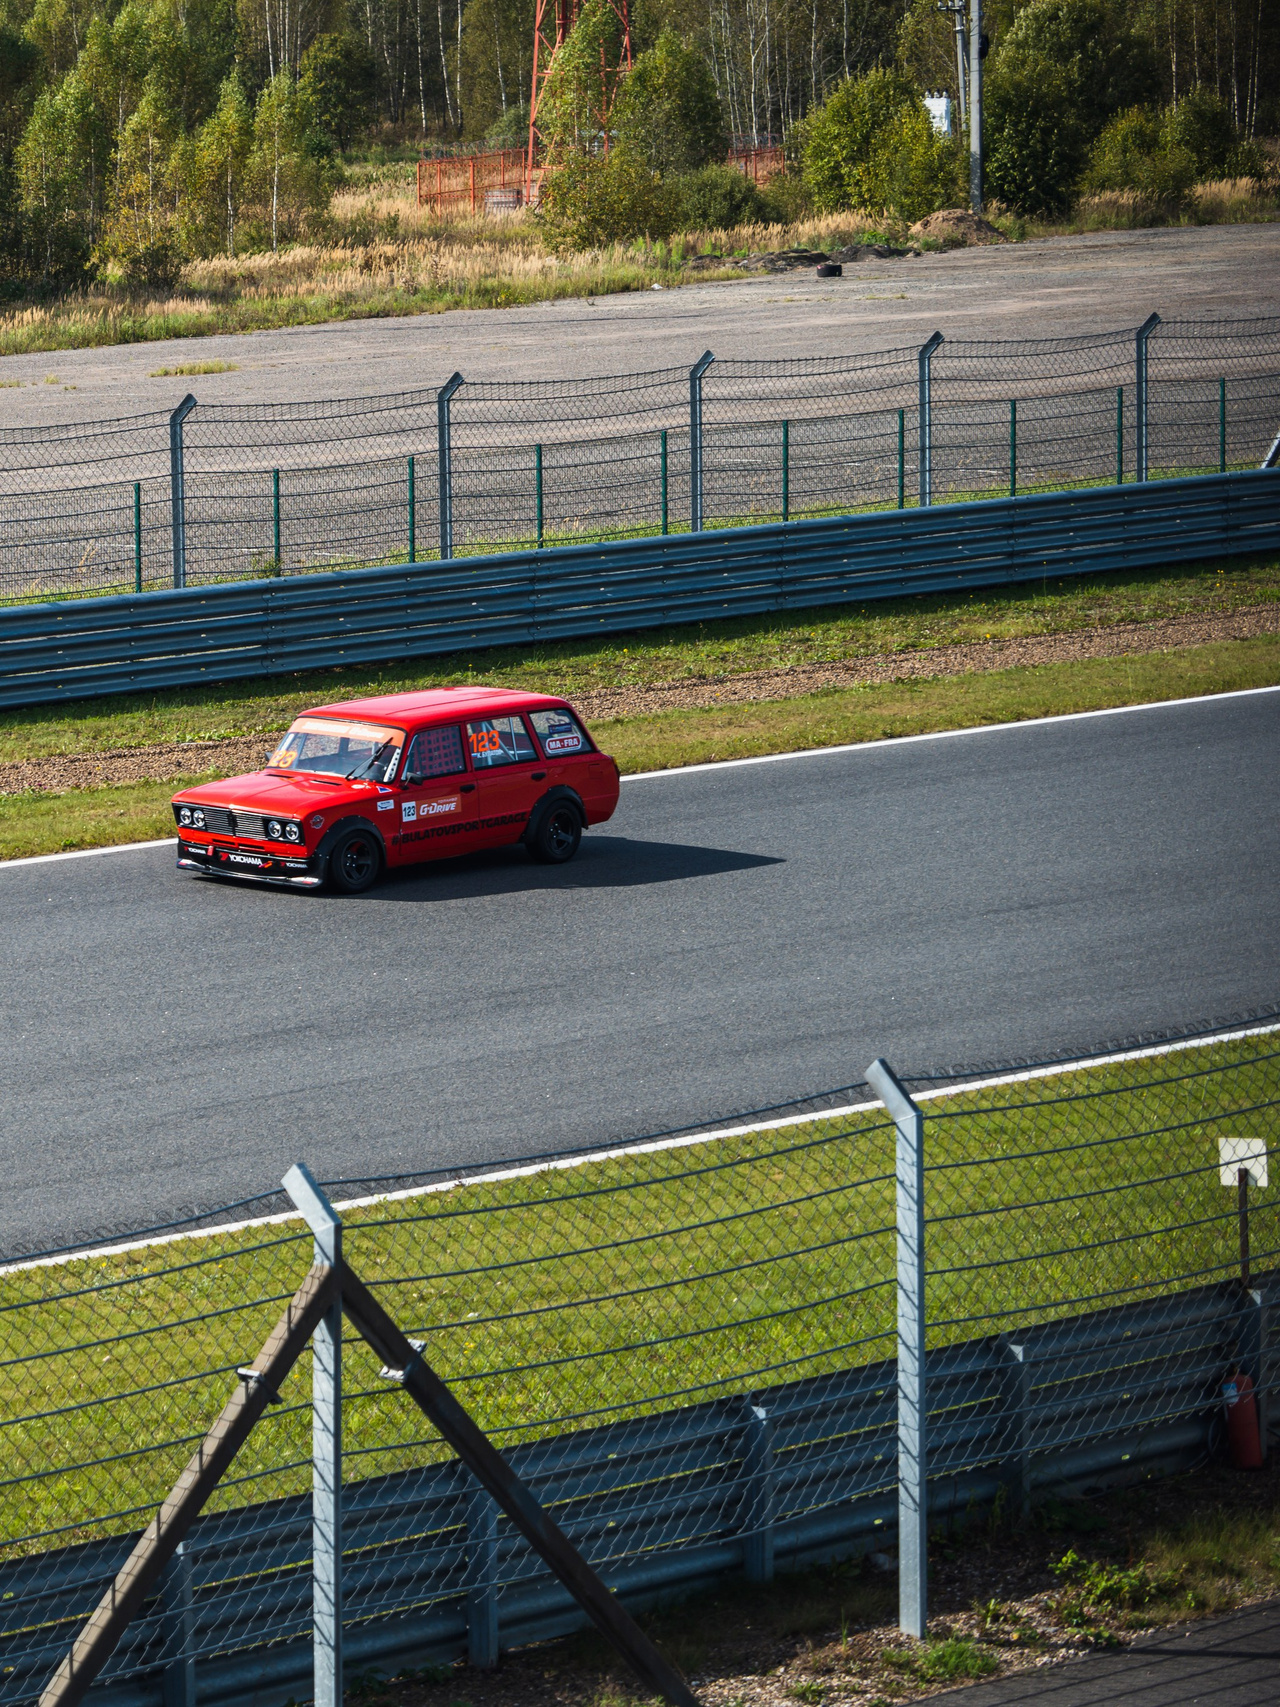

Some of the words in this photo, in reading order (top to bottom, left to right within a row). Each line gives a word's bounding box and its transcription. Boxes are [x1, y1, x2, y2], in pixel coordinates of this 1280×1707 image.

[469, 730, 500, 753] 123
[403, 805, 416, 817] 123
[229, 855, 263, 866] YOKOHAMA
